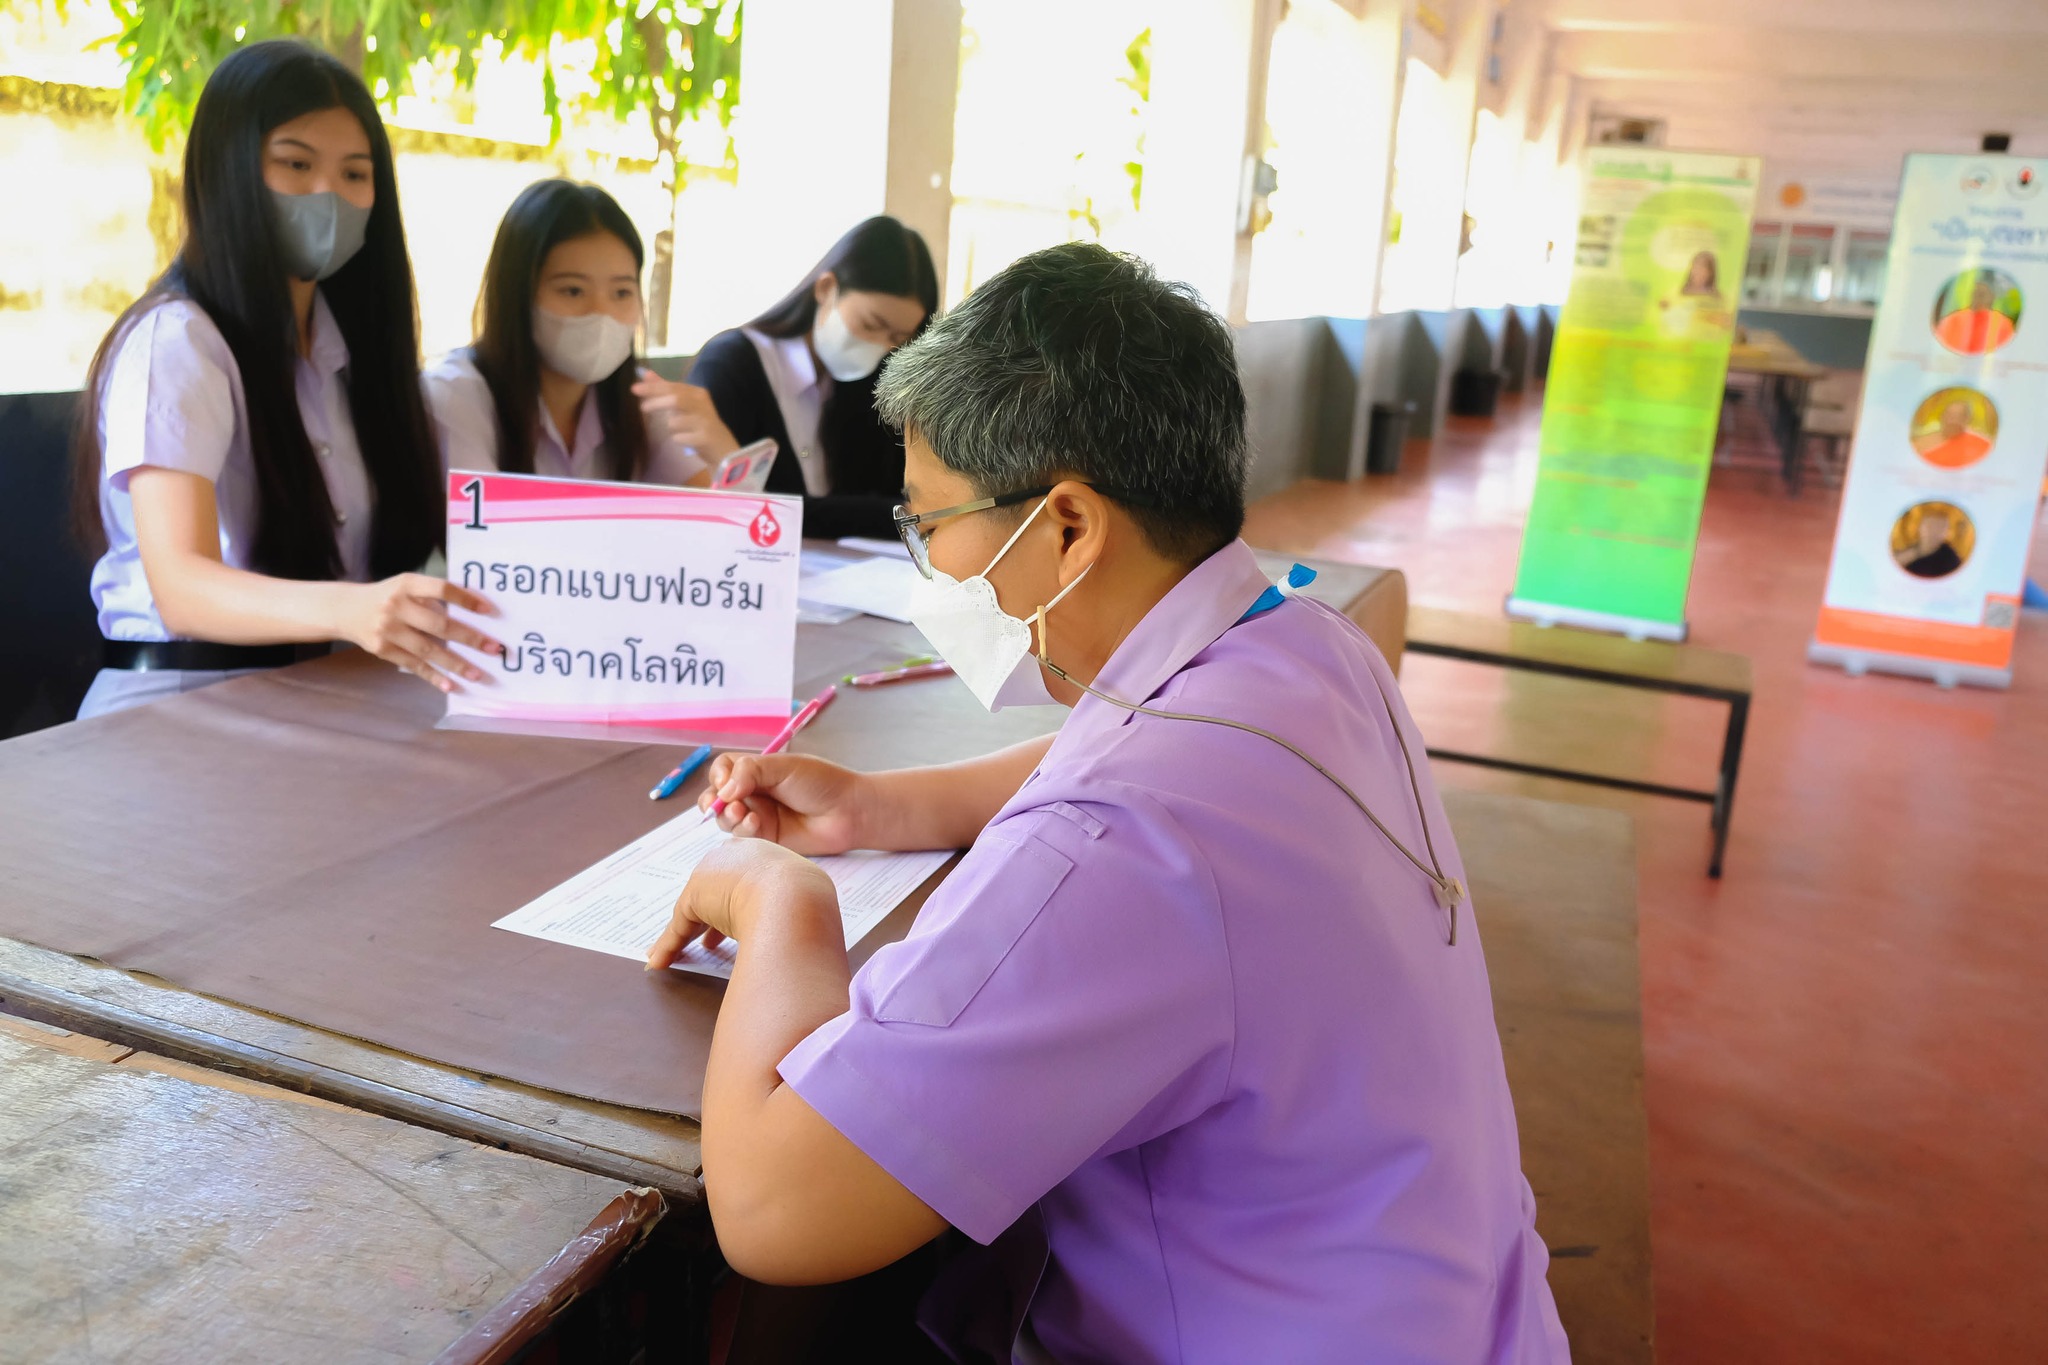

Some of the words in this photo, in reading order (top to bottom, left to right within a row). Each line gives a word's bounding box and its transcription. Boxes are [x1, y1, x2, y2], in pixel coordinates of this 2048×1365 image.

[463, 480, 488, 531] 1
[463, 561, 763, 610] กรอกแบบฟอร์ม
[499, 632, 724, 687] บริจาคโลหิต
